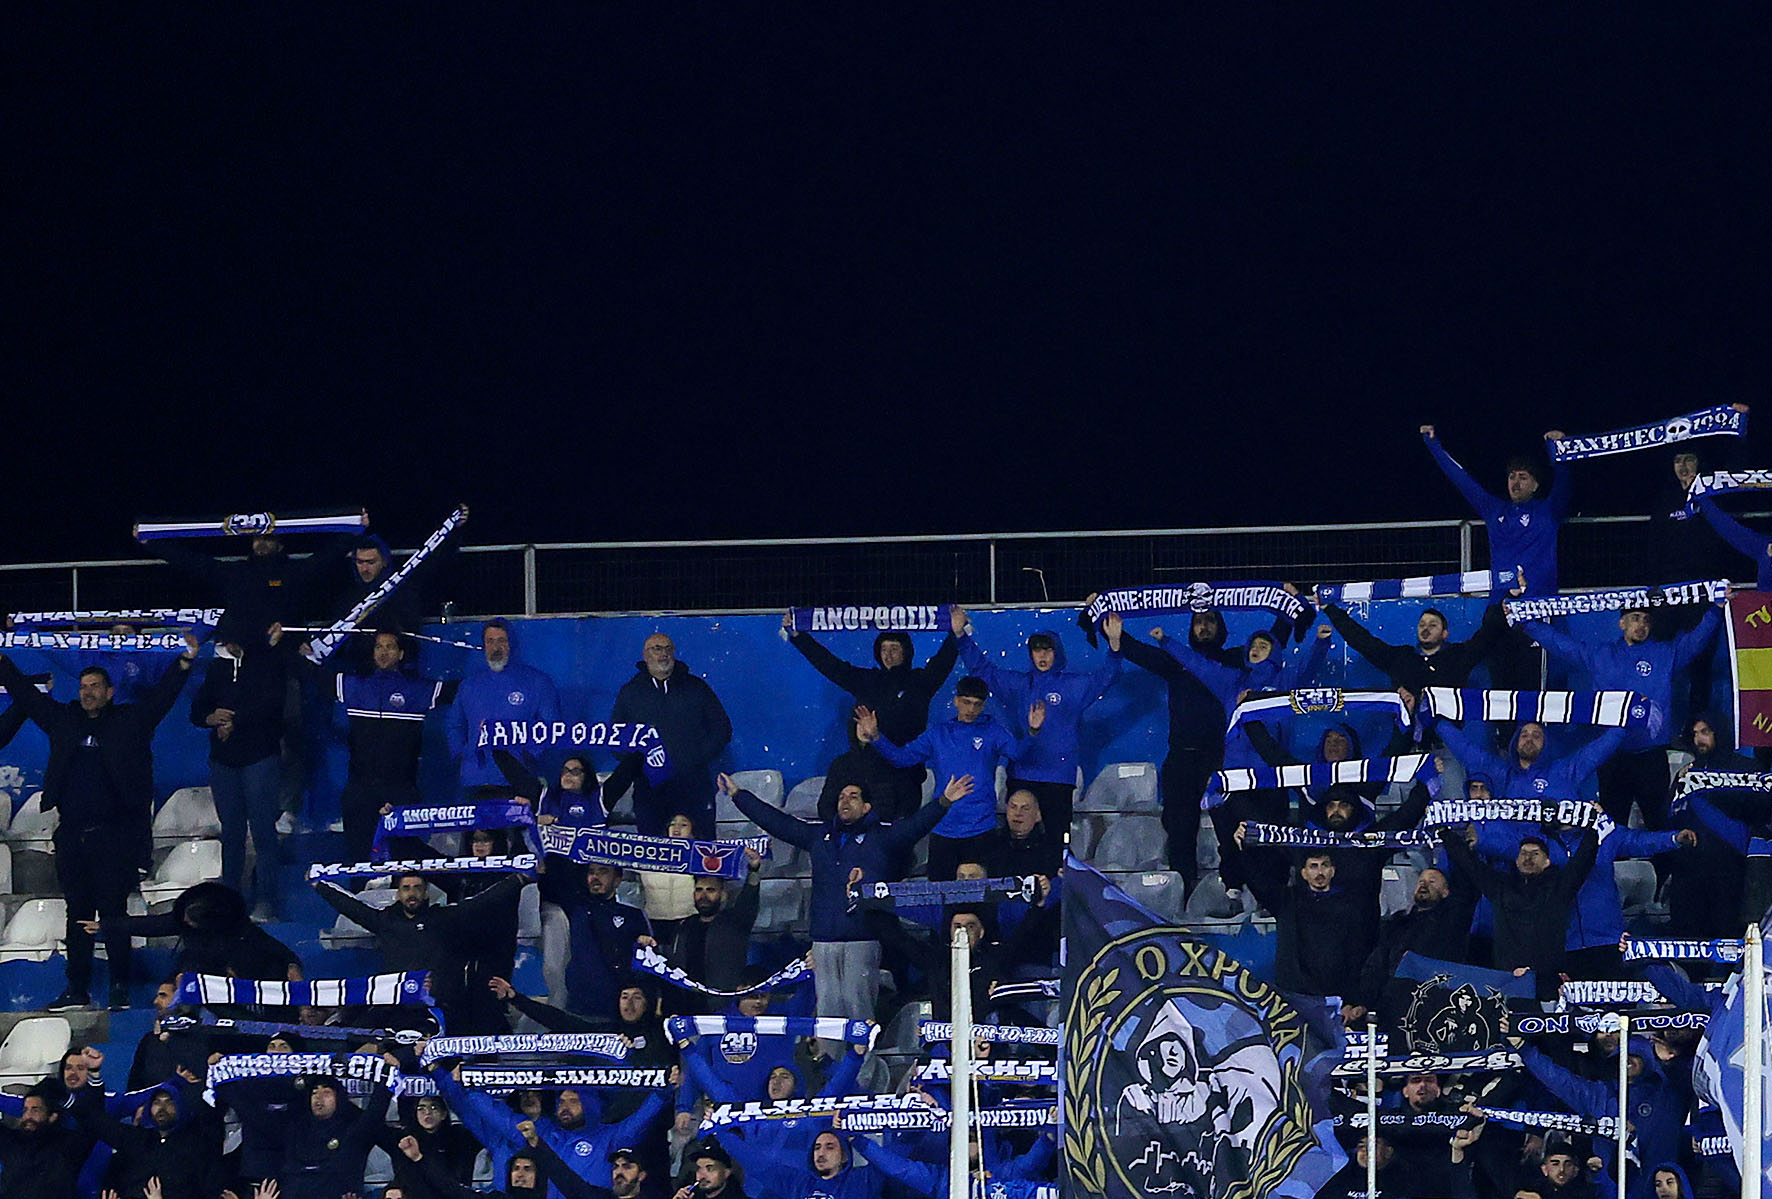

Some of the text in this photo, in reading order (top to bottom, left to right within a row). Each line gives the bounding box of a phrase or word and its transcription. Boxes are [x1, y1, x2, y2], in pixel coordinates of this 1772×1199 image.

[1663, 582, 1717, 605] CITY
[586, 838, 683, 863] ΑΝΟΡΘΩΣΗ
[1517, 1012, 1711, 1034] ON TOUR
[461, 1070, 543, 1087] FREEDOM
